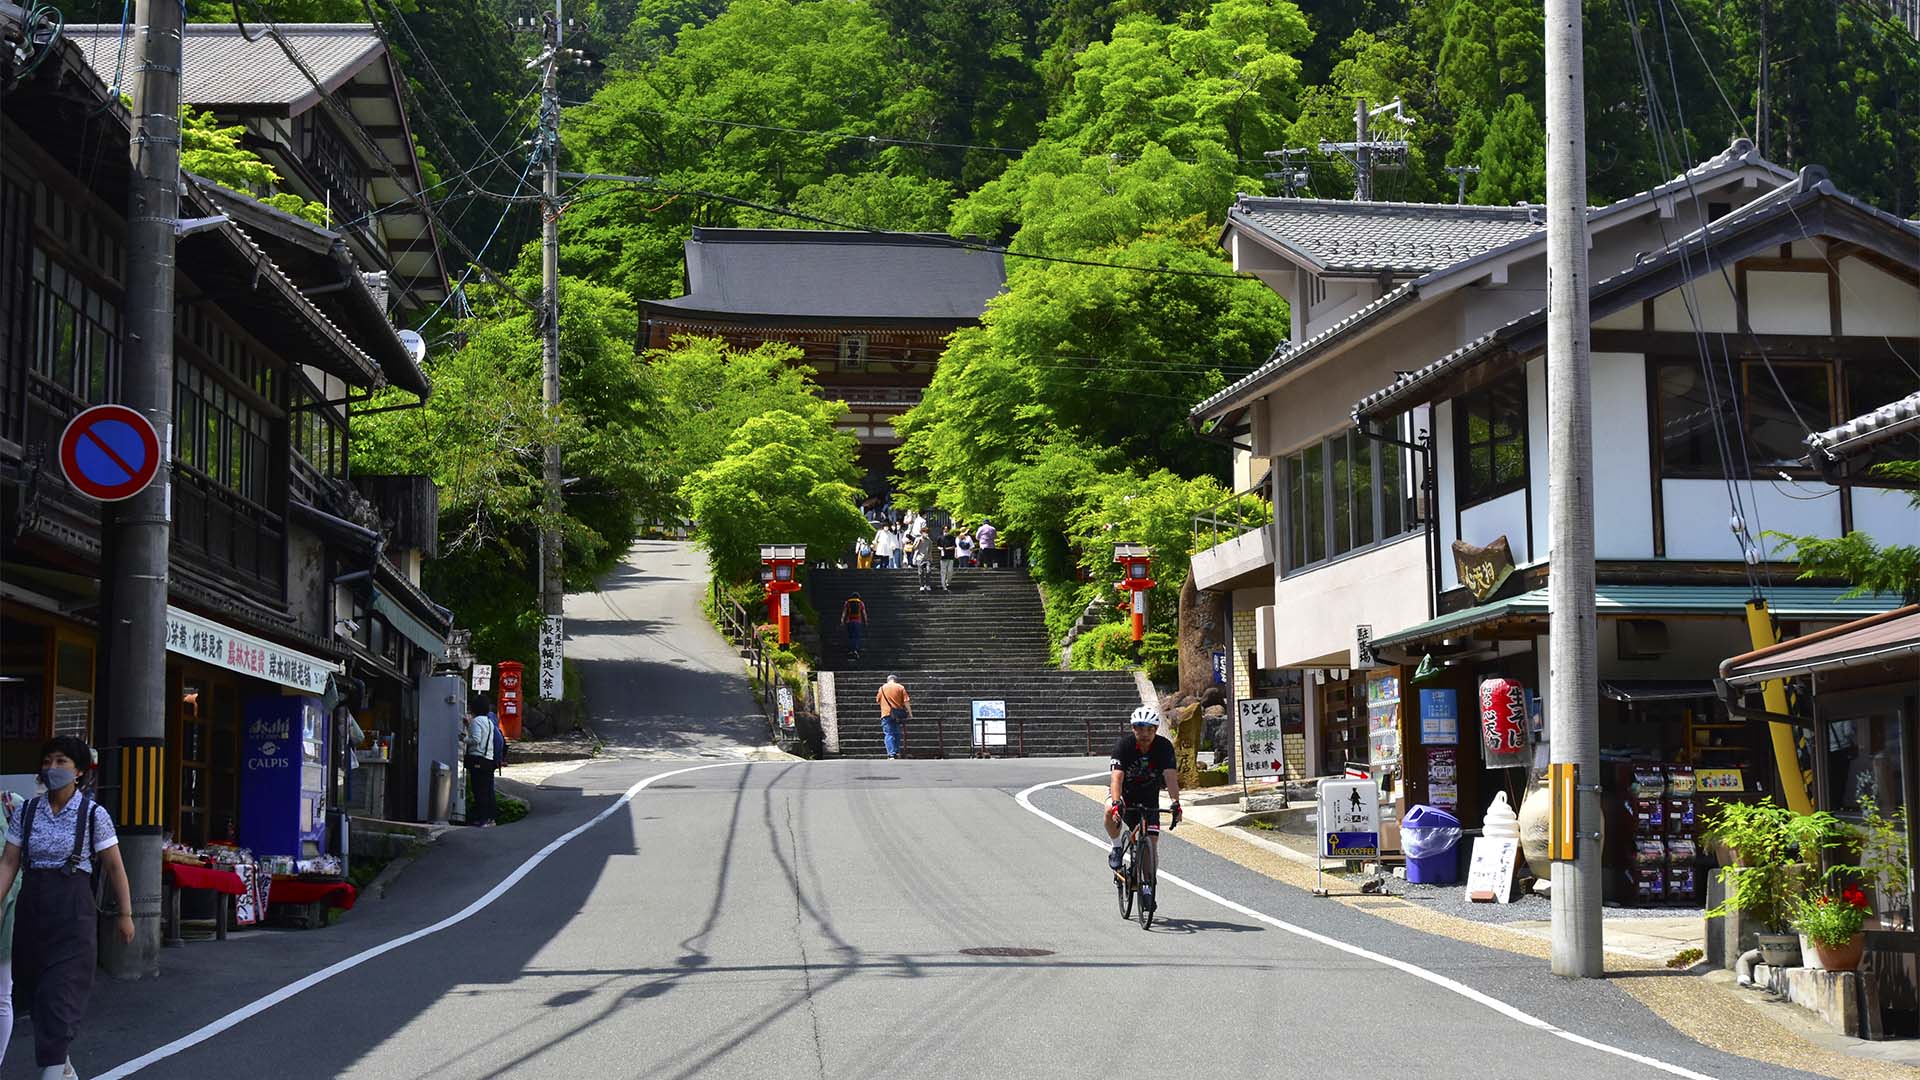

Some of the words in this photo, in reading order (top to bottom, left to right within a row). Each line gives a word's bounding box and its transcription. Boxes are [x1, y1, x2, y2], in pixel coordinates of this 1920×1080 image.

[1242, 702, 1272, 716] うどん
[1254, 715, 1279, 728] そば
[248, 758, 289, 770] CALPIS
[1350, 848, 1376, 856] COFFEE
